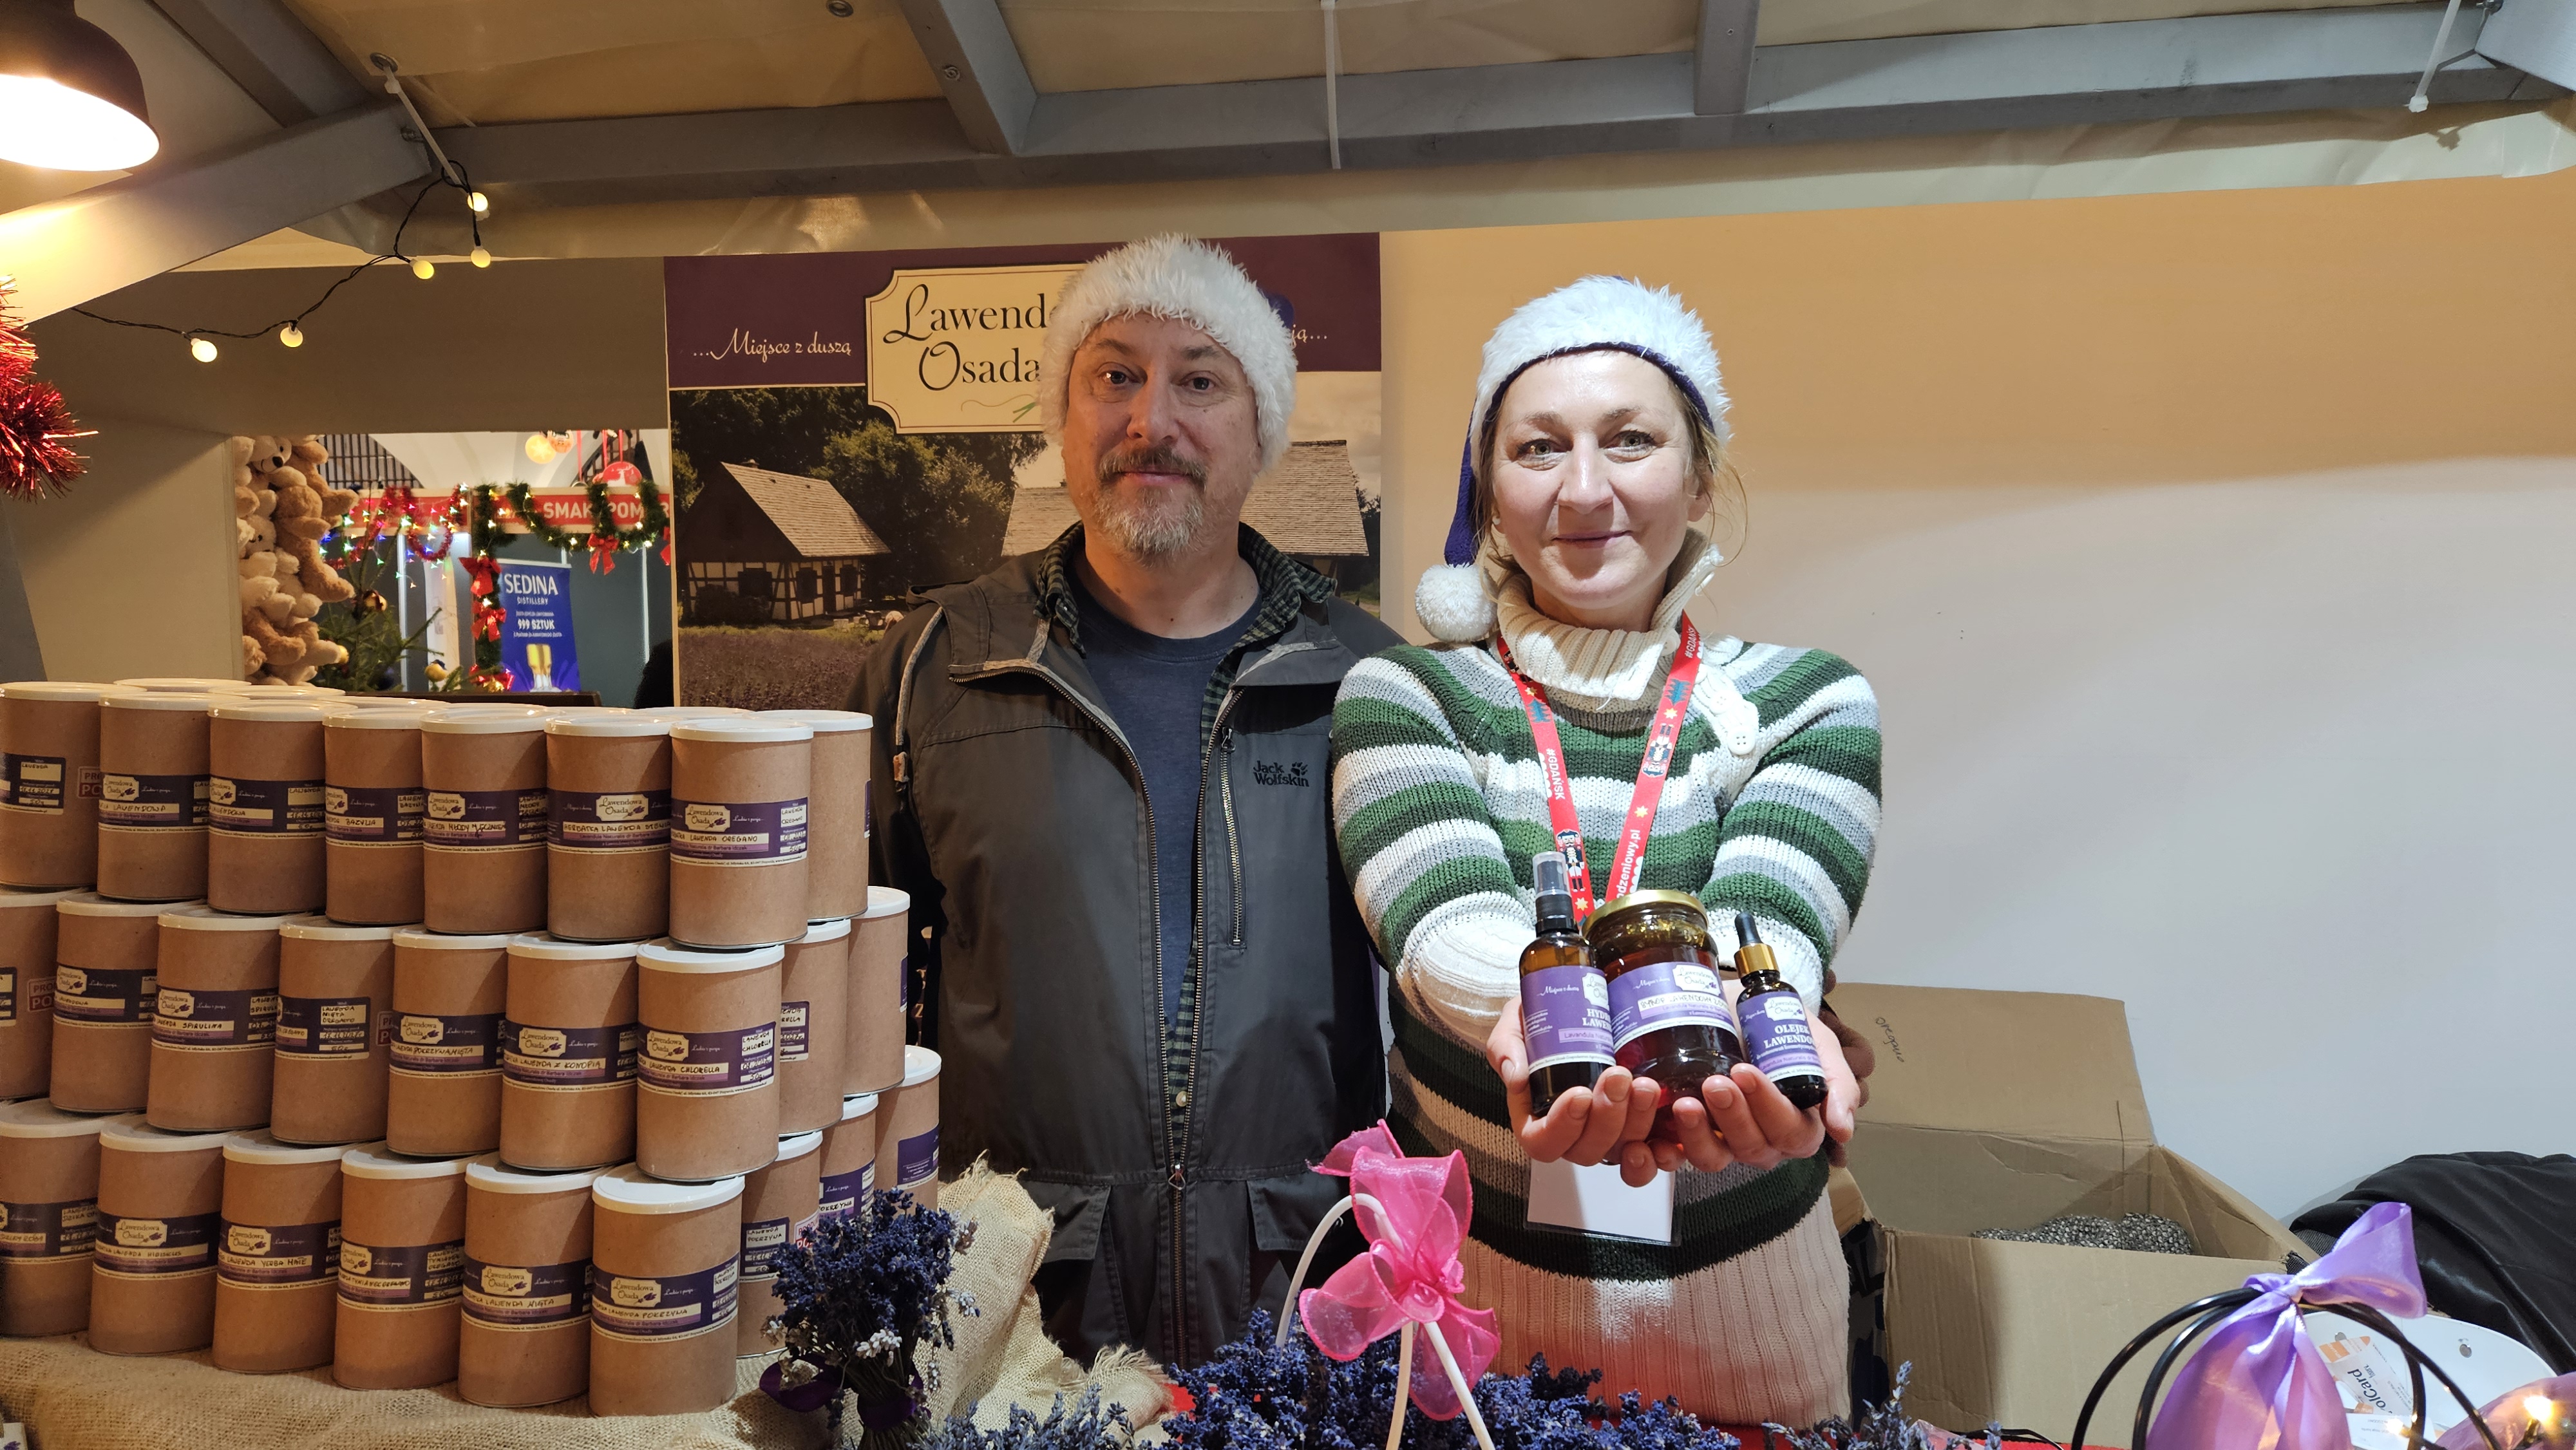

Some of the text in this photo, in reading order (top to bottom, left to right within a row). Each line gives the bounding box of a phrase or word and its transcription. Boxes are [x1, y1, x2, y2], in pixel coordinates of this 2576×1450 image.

[883, 283, 1054, 343] Lawend
[795, 342, 803, 353] z
[807, 331, 851, 356] duszą
[1292, 324, 1327, 348] ją...
[919, 341, 1039, 391] Osada
[544, 502, 591, 519] SMAK
[504, 574, 558, 596] SEDINA
[517, 596, 548, 605] DISTILLERY
[518, 618, 555, 630] 999 SZTUK
[1253, 760, 1284, 773] Jack
[1546, 748, 1566, 800] #GDAŃSK
[1253, 772, 1309, 787] Wolfskin
[600, 797, 642, 807] Lawendowa
[605, 806, 628, 815] Osada
[1616, 829, 1641, 899] odzeniowy.pl
[1774, 1024, 1810, 1035] OLEJEK
[1763, 1034, 1815, 1049] LAWENDO
[484, 1268, 525, 1280] Lawendowa
[613, 1280, 654, 1291] Lawendowa
[2347, 1368, 2392, 1414] olCard
